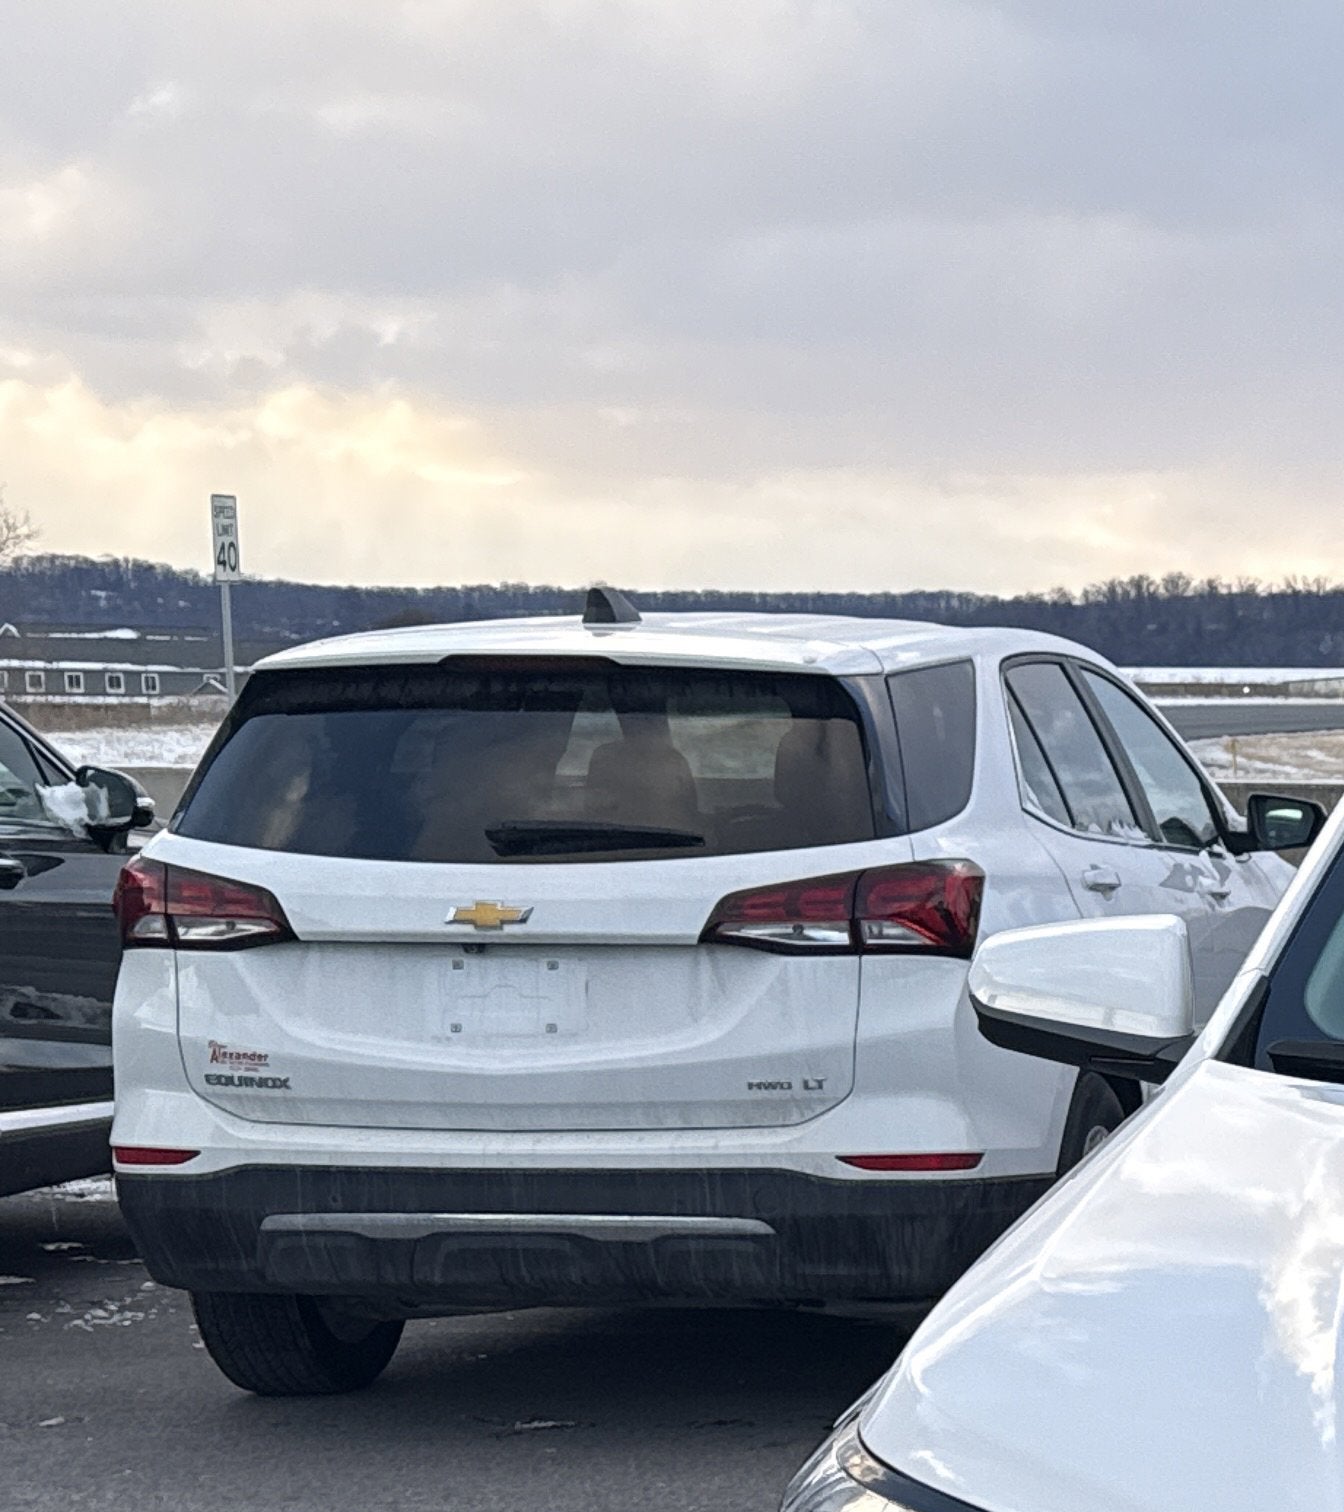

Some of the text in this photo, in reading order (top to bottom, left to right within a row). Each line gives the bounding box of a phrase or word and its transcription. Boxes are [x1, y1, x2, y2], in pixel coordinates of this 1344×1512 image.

[217, 541, 237, 572] 40
[204, 1073, 292, 1090] EQUINOX
[803, 1078, 827, 1091] LT
